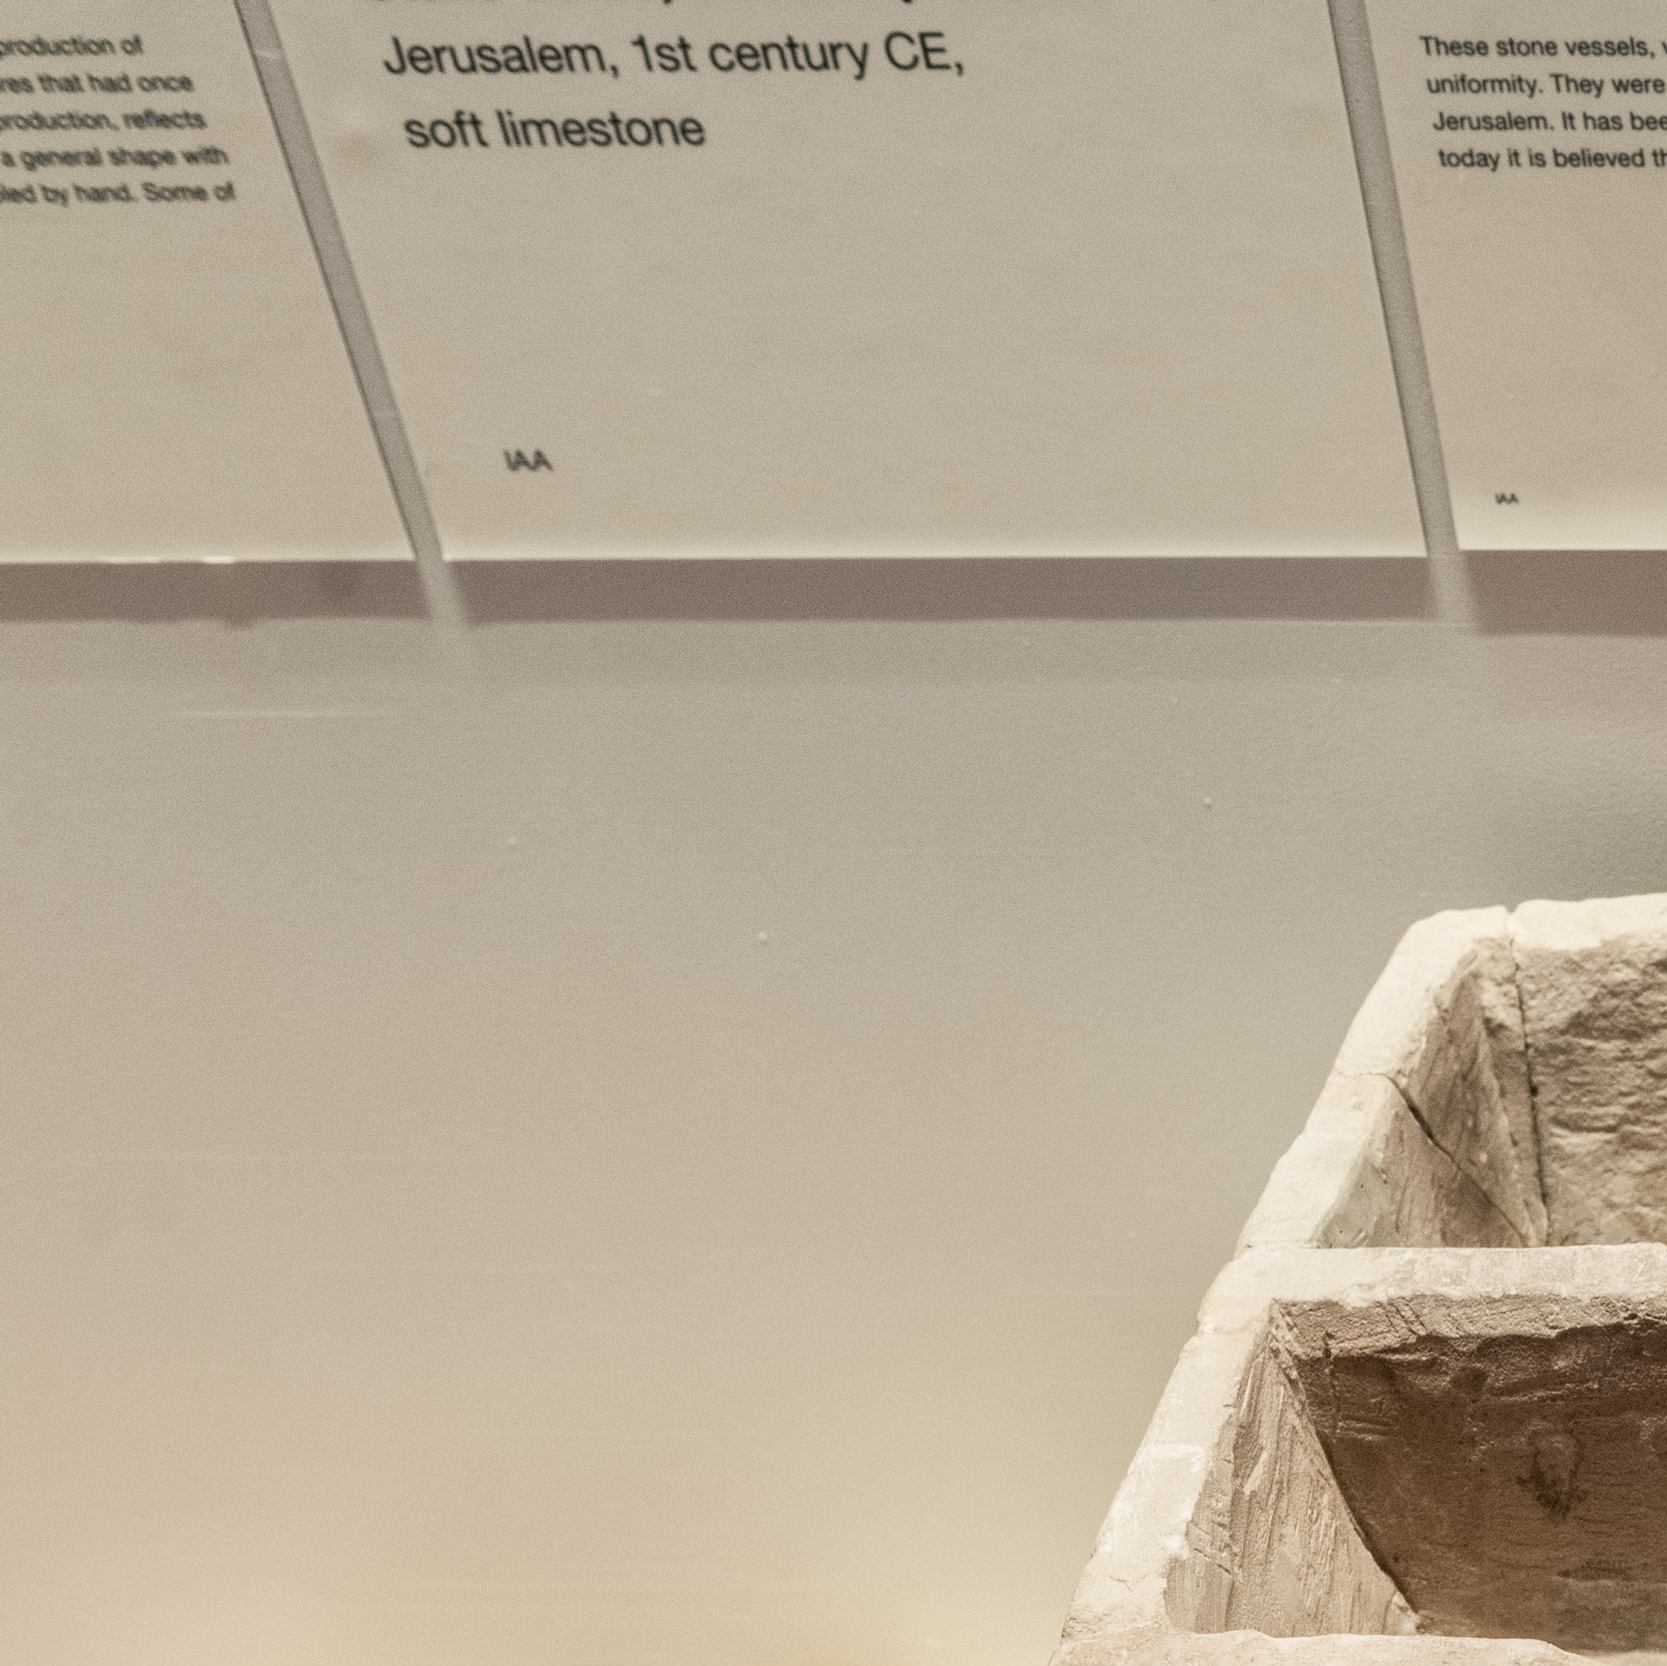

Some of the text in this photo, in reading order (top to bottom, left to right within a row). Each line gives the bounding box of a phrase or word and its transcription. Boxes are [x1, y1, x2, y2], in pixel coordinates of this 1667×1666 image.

[119, 33, 145, 57] of
[382, 29, 965, 82] Jerusalem, 1st century CE,
[1418, 34, 1490, 59] These
[1494, 36, 1559, 59] stone
[1563, 35, 1656, 60] vessels,
[36, 73, 85, 94] that
[85, 72, 134, 94] had
[136, 74, 195, 94] once
[1425, 72, 1544, 100] uniformity.
[1548, 72, 1605, 100] They
[1610, 77, 1667, 96] were
[122, 107, 209, 132] reflects
[403, 108, 707, 150] soft limestone
[1432, 110, 1555, 133] Jerusalem.
[1560, 110, 1577, 132] It
[1581, 110, 1625, 133] has
[0, 144, 230, 173] a general shape with
[1437, 147, 1501, 174] today
[1506, 147, 1523, 169] it
[1527, 147, 1548, 170] is
[1551, 147, 1647, 170] believed
[38, 183, 70, 209] by
[71, 182, 138, 205] hand.
[140, 180, 210, 204] Some
[212, 180, 237, 204] of
[503, 448, 554, 473] IAA
[1494, 492, 1520, 505] IAA
